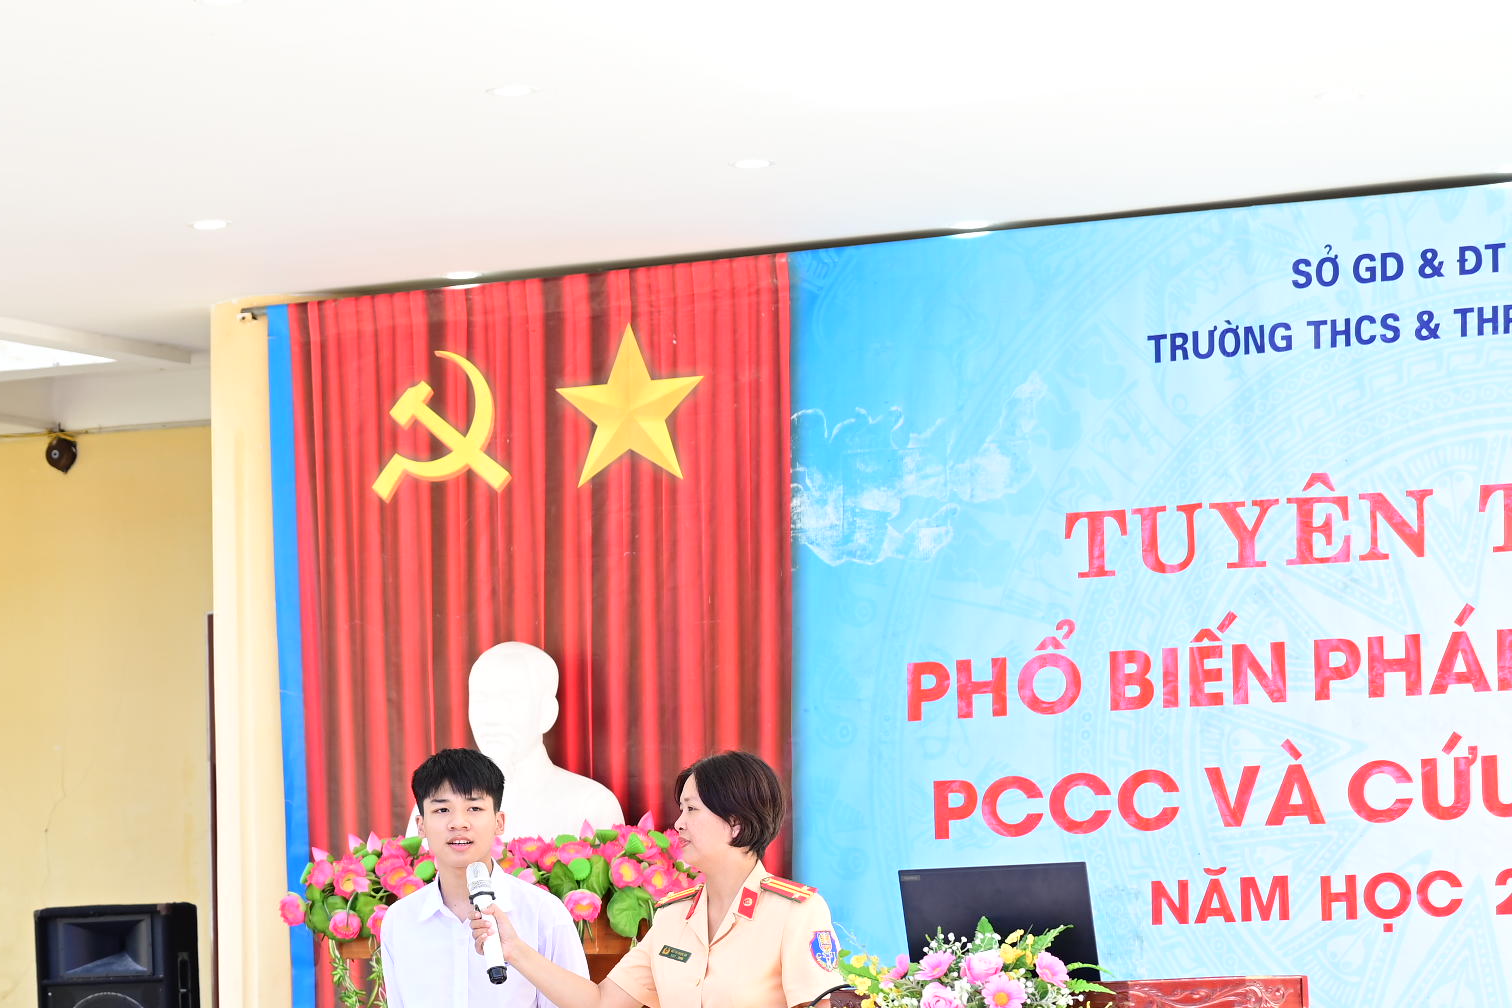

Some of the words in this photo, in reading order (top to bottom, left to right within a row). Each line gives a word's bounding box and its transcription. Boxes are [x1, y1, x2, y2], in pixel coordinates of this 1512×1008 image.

[1291, 244, 1339, 289] SỞ
[1353, 252, 1404, 284] GD
[1418, 248, 1445, 279] &
[1456, 242, 1506, 275] ĐT
[1147, 314, 1293, 364] TRƯỜNG
[1307, 313, 1401, 350] THCS
[1414, 310, 1441, 341] &
[1064, 472, 1433, 579] TUYÊN
[906, 619, 1082, 722] PHỔ
[1109, 610, 1287, 712] BIẾN
[933, 769, 1181, 840] PCCC
[1205, 738, 1326, 828] VÀ
[1150, 866, 1291, 926] NĂM
[1320, 869, 1464, 932] HỌC
